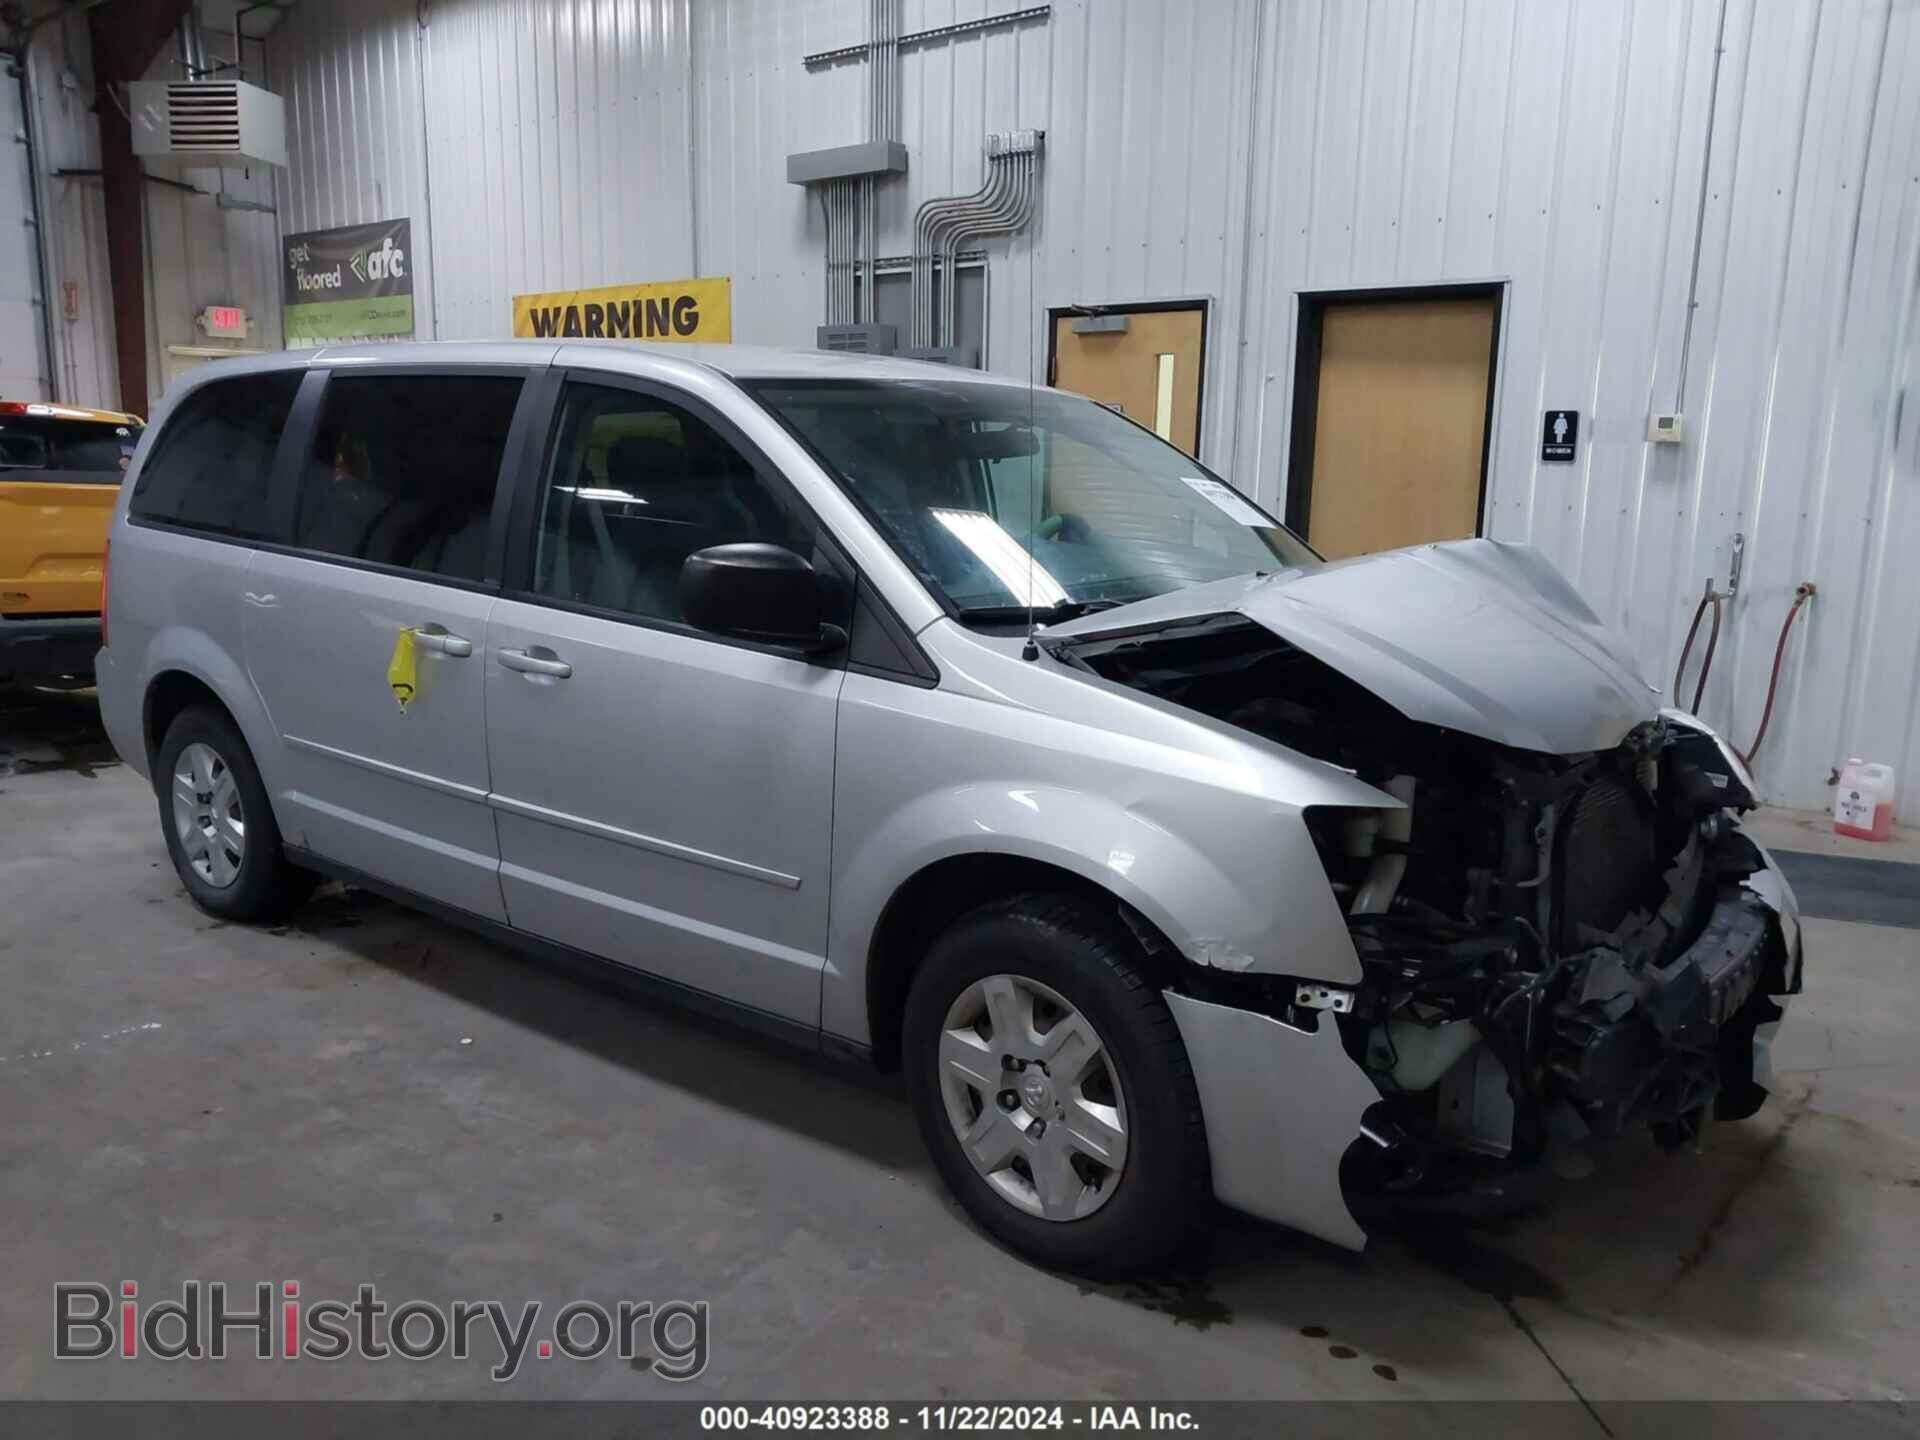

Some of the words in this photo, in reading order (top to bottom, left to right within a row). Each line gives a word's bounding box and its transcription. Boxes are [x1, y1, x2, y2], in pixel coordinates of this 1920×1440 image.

[288, 242, 311, 270] get
[367, 238, 404, 281] afc
[296, 264, 342, 291] floored
[529, 295, 699, 339] WARNING
